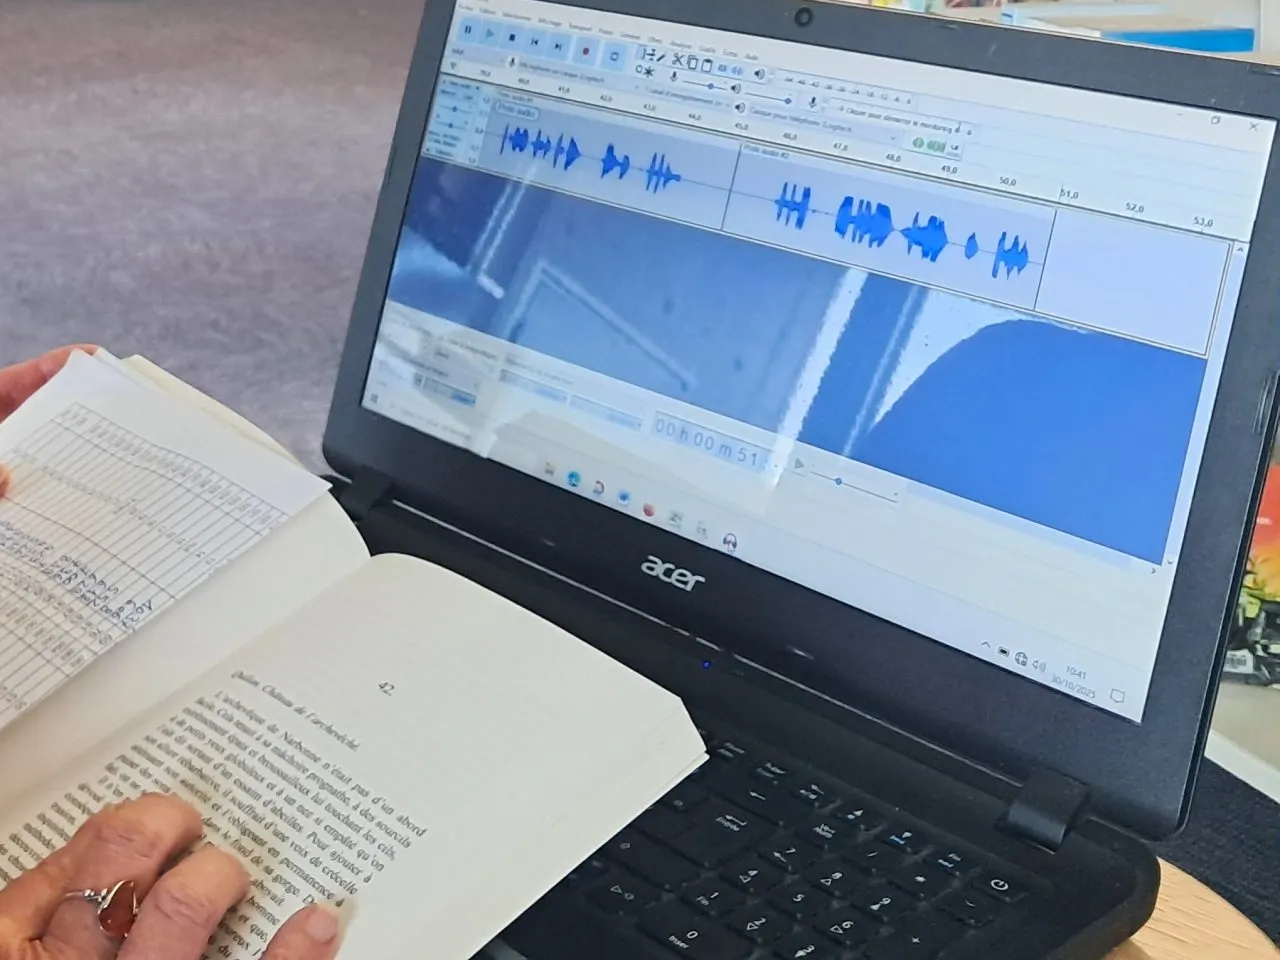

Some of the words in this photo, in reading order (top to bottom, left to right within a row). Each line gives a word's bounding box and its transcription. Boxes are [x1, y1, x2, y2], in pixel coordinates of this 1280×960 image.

[885, 153, 901, 163] 48,0
[941, 165, 958, 174] 49,0
[999, 176, 1017, 186] 50,0
[1059, 186, 1079, 199] 51,0
[1126, 202, 1145, 213] 52,0
[1194, 216, 1213, 228] 53,0
[654, 418, 676, 437] 00
[679, 426, 688, 441] h
[693, 432, 715, 451] 00
[718, 444, 732, 458] m
[737, 447, 757, 466] 51
[641, 555, 706, 592] acer
[280, 731, 321, 763] Narbonne
[322, 762, 353, 785] n'était
[350, 783, 370, 798] pas
[371, 796, 394, 815] d'un
[396, 815, 428, 837] abord
[212, 762, 233, 780] d'un
[233, 778, 262, 801] essaim
[306, 831, 330, 851] Pour
[329, 850, 363, 876] ajouter
[283, 794, 296, 806] un
[356, 849, 385, 872] qu'on
[324, 803, 364, 834] touchant
[362, 829, 377, 845] les
[359, 808, 375, 822] des
[375, 821, 412, 848] sourcils
[211, 803, 222, 812] et
[267, 847, 280, 858] en
[277, 857, 336, 900] permanence
[228, 795, 266, 824] souffrait
[263, 821, 290, 843] d'une
[289, 841, 309, 859] voix
[309, 856, 323, 868] de
[321, 866, 358, 895] crécelle
[250, 855, 264, 867] de
[271, 873, 300, 897] gorge.
[246, 896, 280, 926] homme
[792, 893, 805, 902] 5
[880, 897, 892, 906] 9
[686, 930, 698, 940] 0
[754, 917, 766, 926] 2
[842, 920, 854, 930] 6
[218, 944, 232, 958] du
[804, 944, 816, 954] 3
